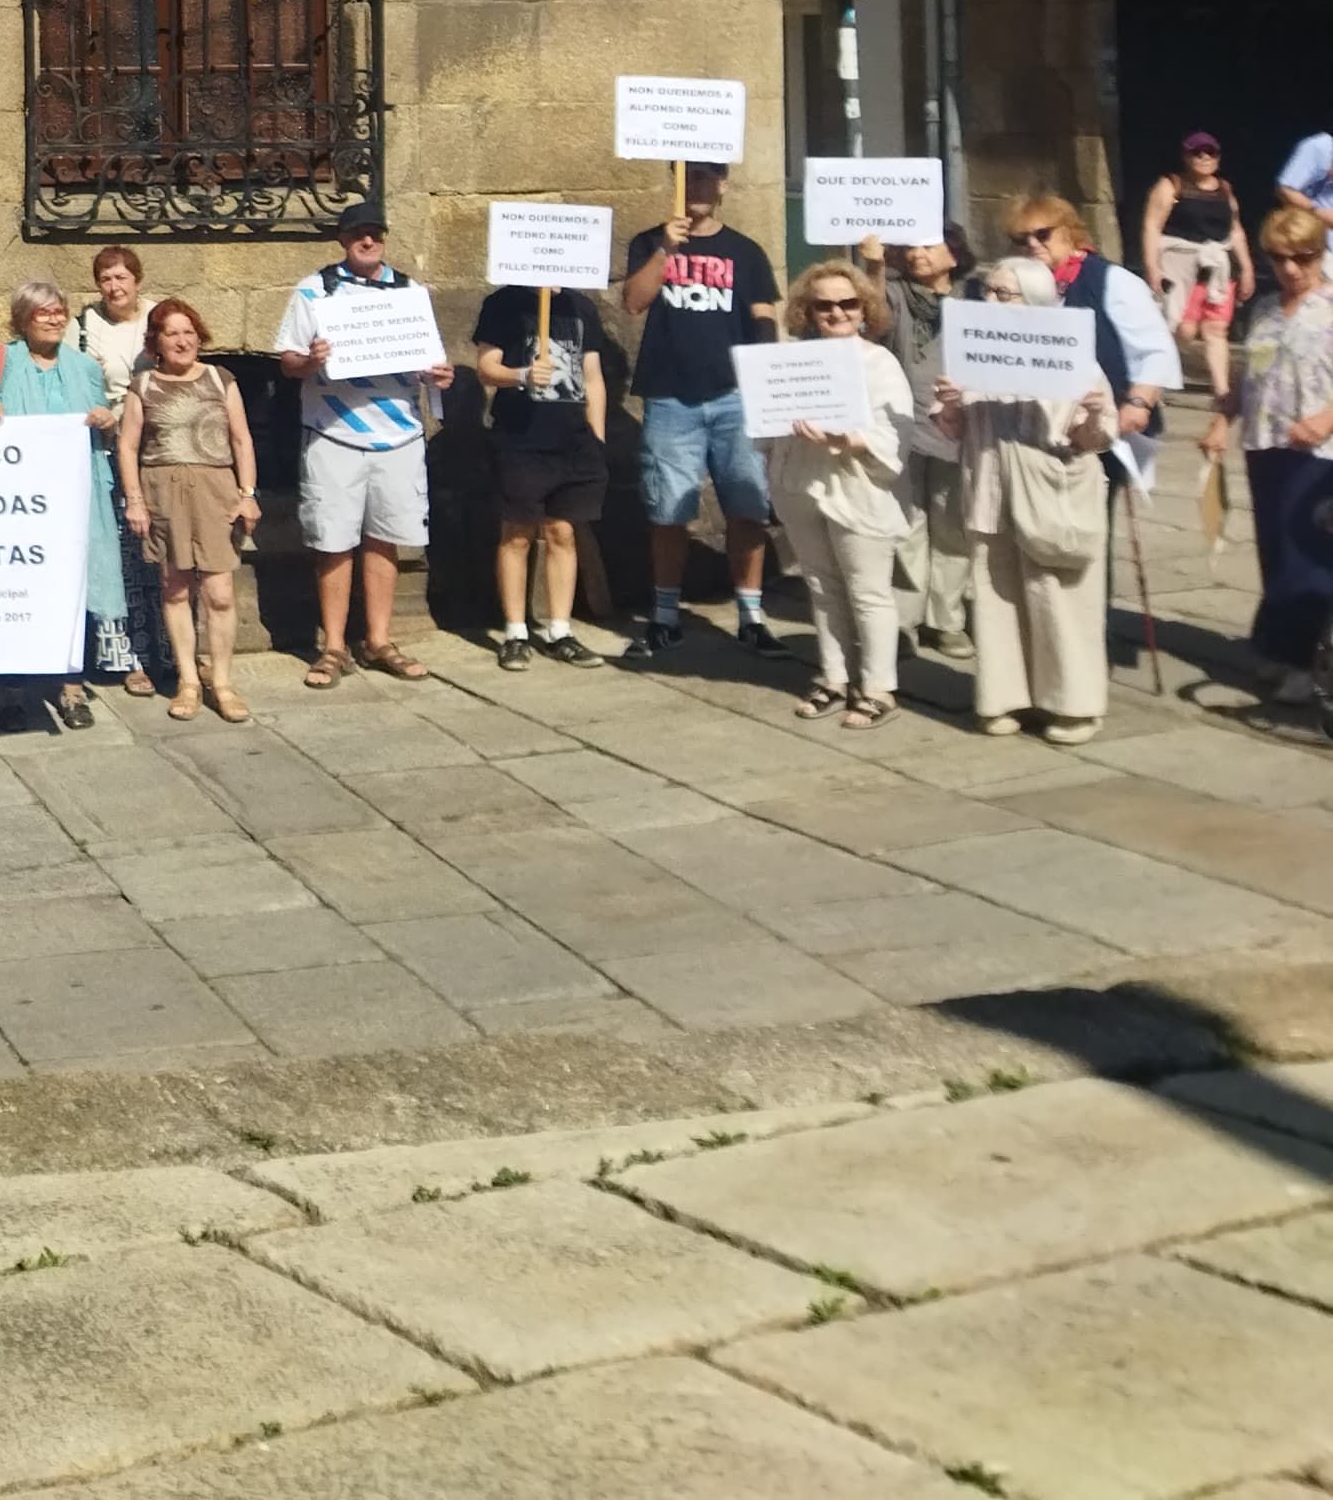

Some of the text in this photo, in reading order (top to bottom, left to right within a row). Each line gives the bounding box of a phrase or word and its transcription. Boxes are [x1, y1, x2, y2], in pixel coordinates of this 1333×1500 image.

[628, 86, 734, 99] NON QUEREMOS A
[630, 104, 732, 116] ALFONSO MOLINA
[662, 122, 698, 131] COMO
[625, 137, 734, 151] FILLO PREDILECTO
[817, 176, 930, 186] QUE DEVOLVAN
[853, 197, 893, 206] TODO
[501, 213, 525, 221] NON
[528, 214, 589, 225] QUEREMOS
[831, 218, 917, 227] O ROUBADO
[510, 231, 546, 240] PEDRO
[533, 247, 565, 255] COMO
[498, 263, 600, 275] FILLO PREDILECTO
[661, 253, 734, 290] ALTRI
[661, 283, 733, 312] NON
[351, 302, 393, 313] DESPOIS
[343, 321, 369, 331] PAZO
[372, 320, 385, 328] DE
[963, 328, 1078, 347] FRANQUISMO
[338, 348, 427, 364] DA CASA CORNIDE
[965, 352, 1026, 367] NUNCA
[4, 612, 32, 622] 2017
